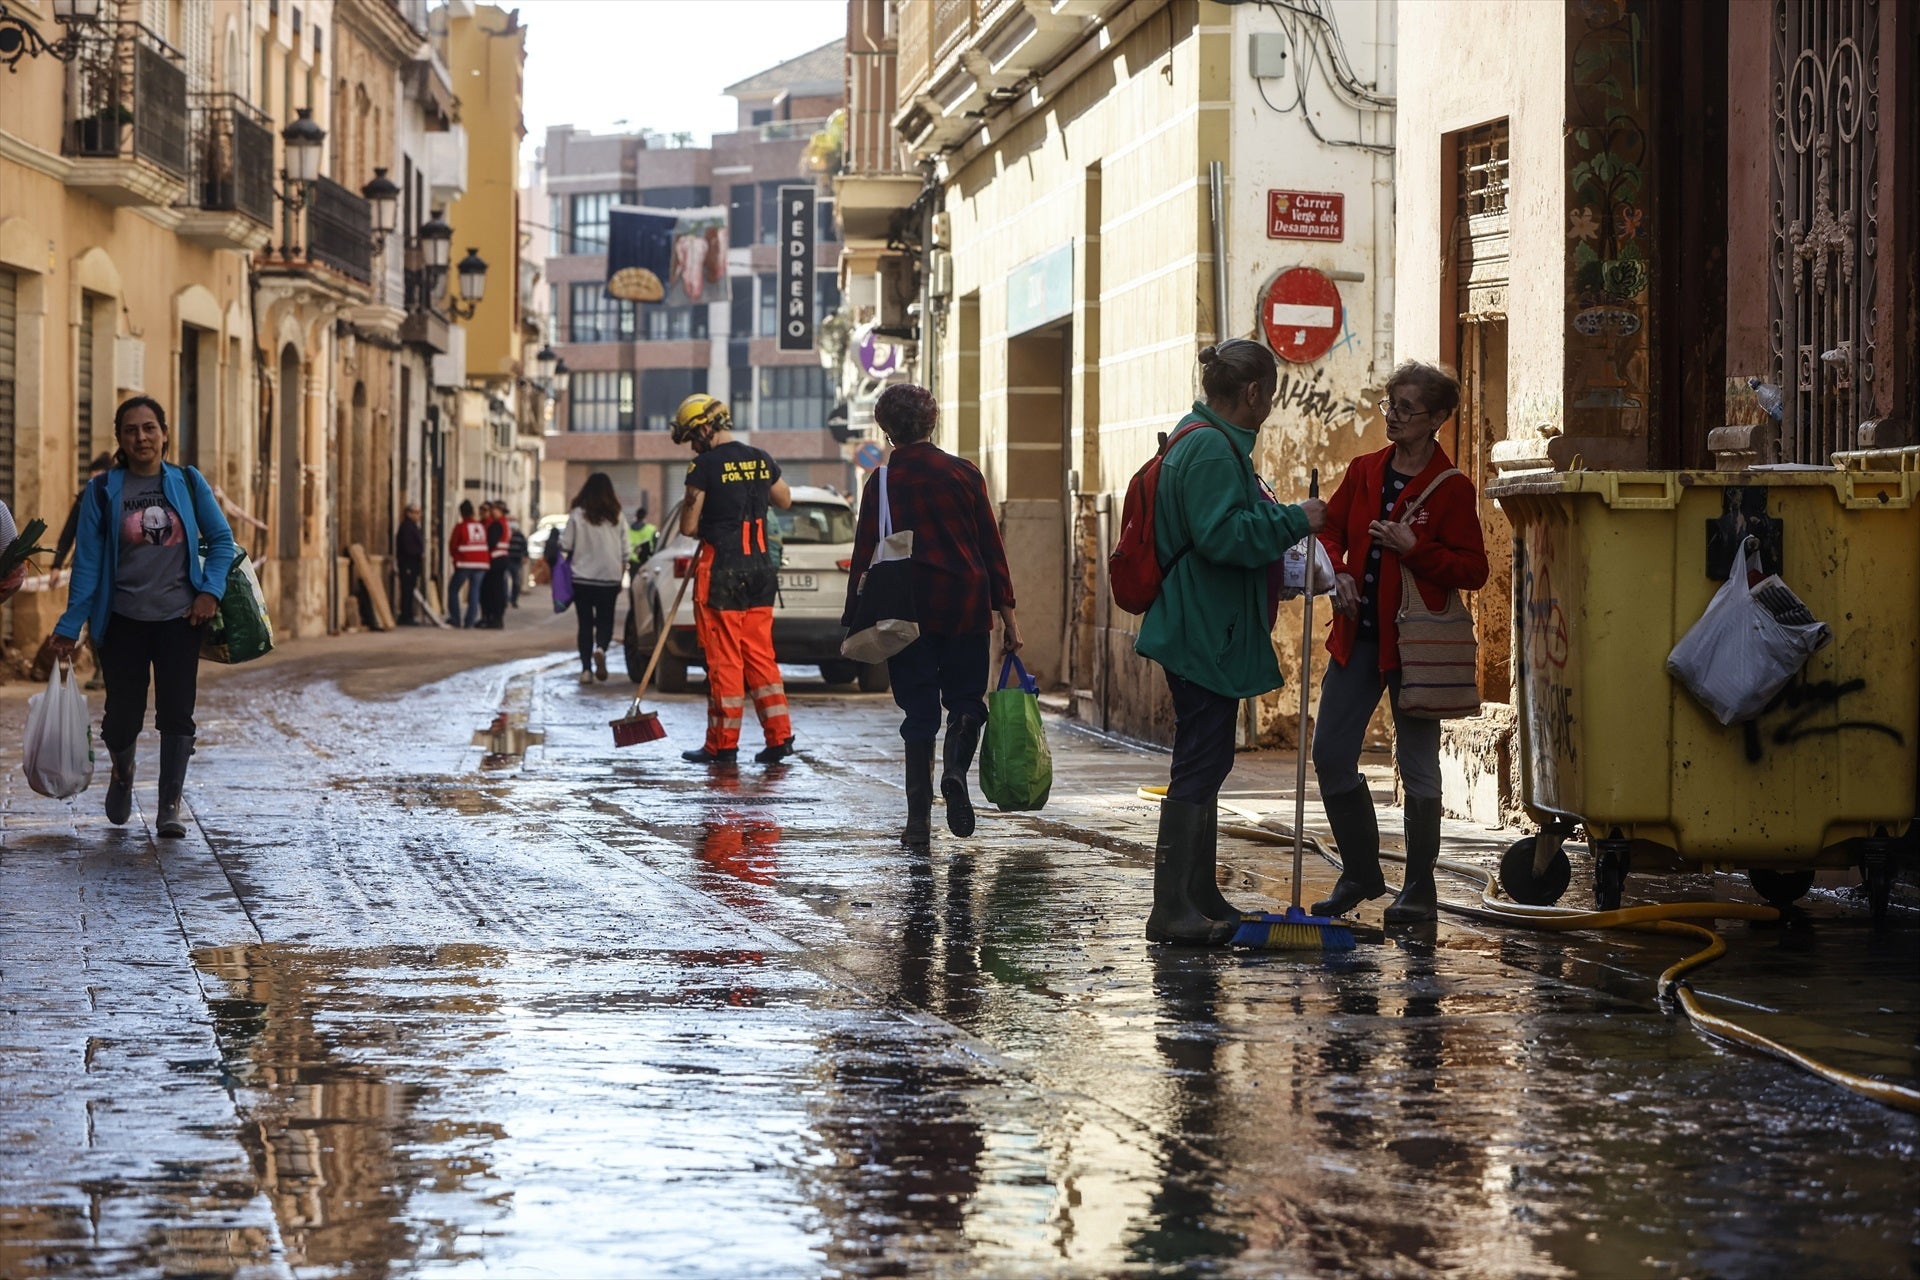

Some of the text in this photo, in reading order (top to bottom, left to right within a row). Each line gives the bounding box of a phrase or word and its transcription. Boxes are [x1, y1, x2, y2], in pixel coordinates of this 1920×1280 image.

[1296, 195, 1332, 209] Carrer
[1292, 208, 1338, 223] Verge dels
[1274, 220, 1339, 235] Desamparats
[788, 200, 805, 337] PEDREÑO
[721, 470, 770, 483] FORSTLS
[789, 575, 813, 587] LLB
